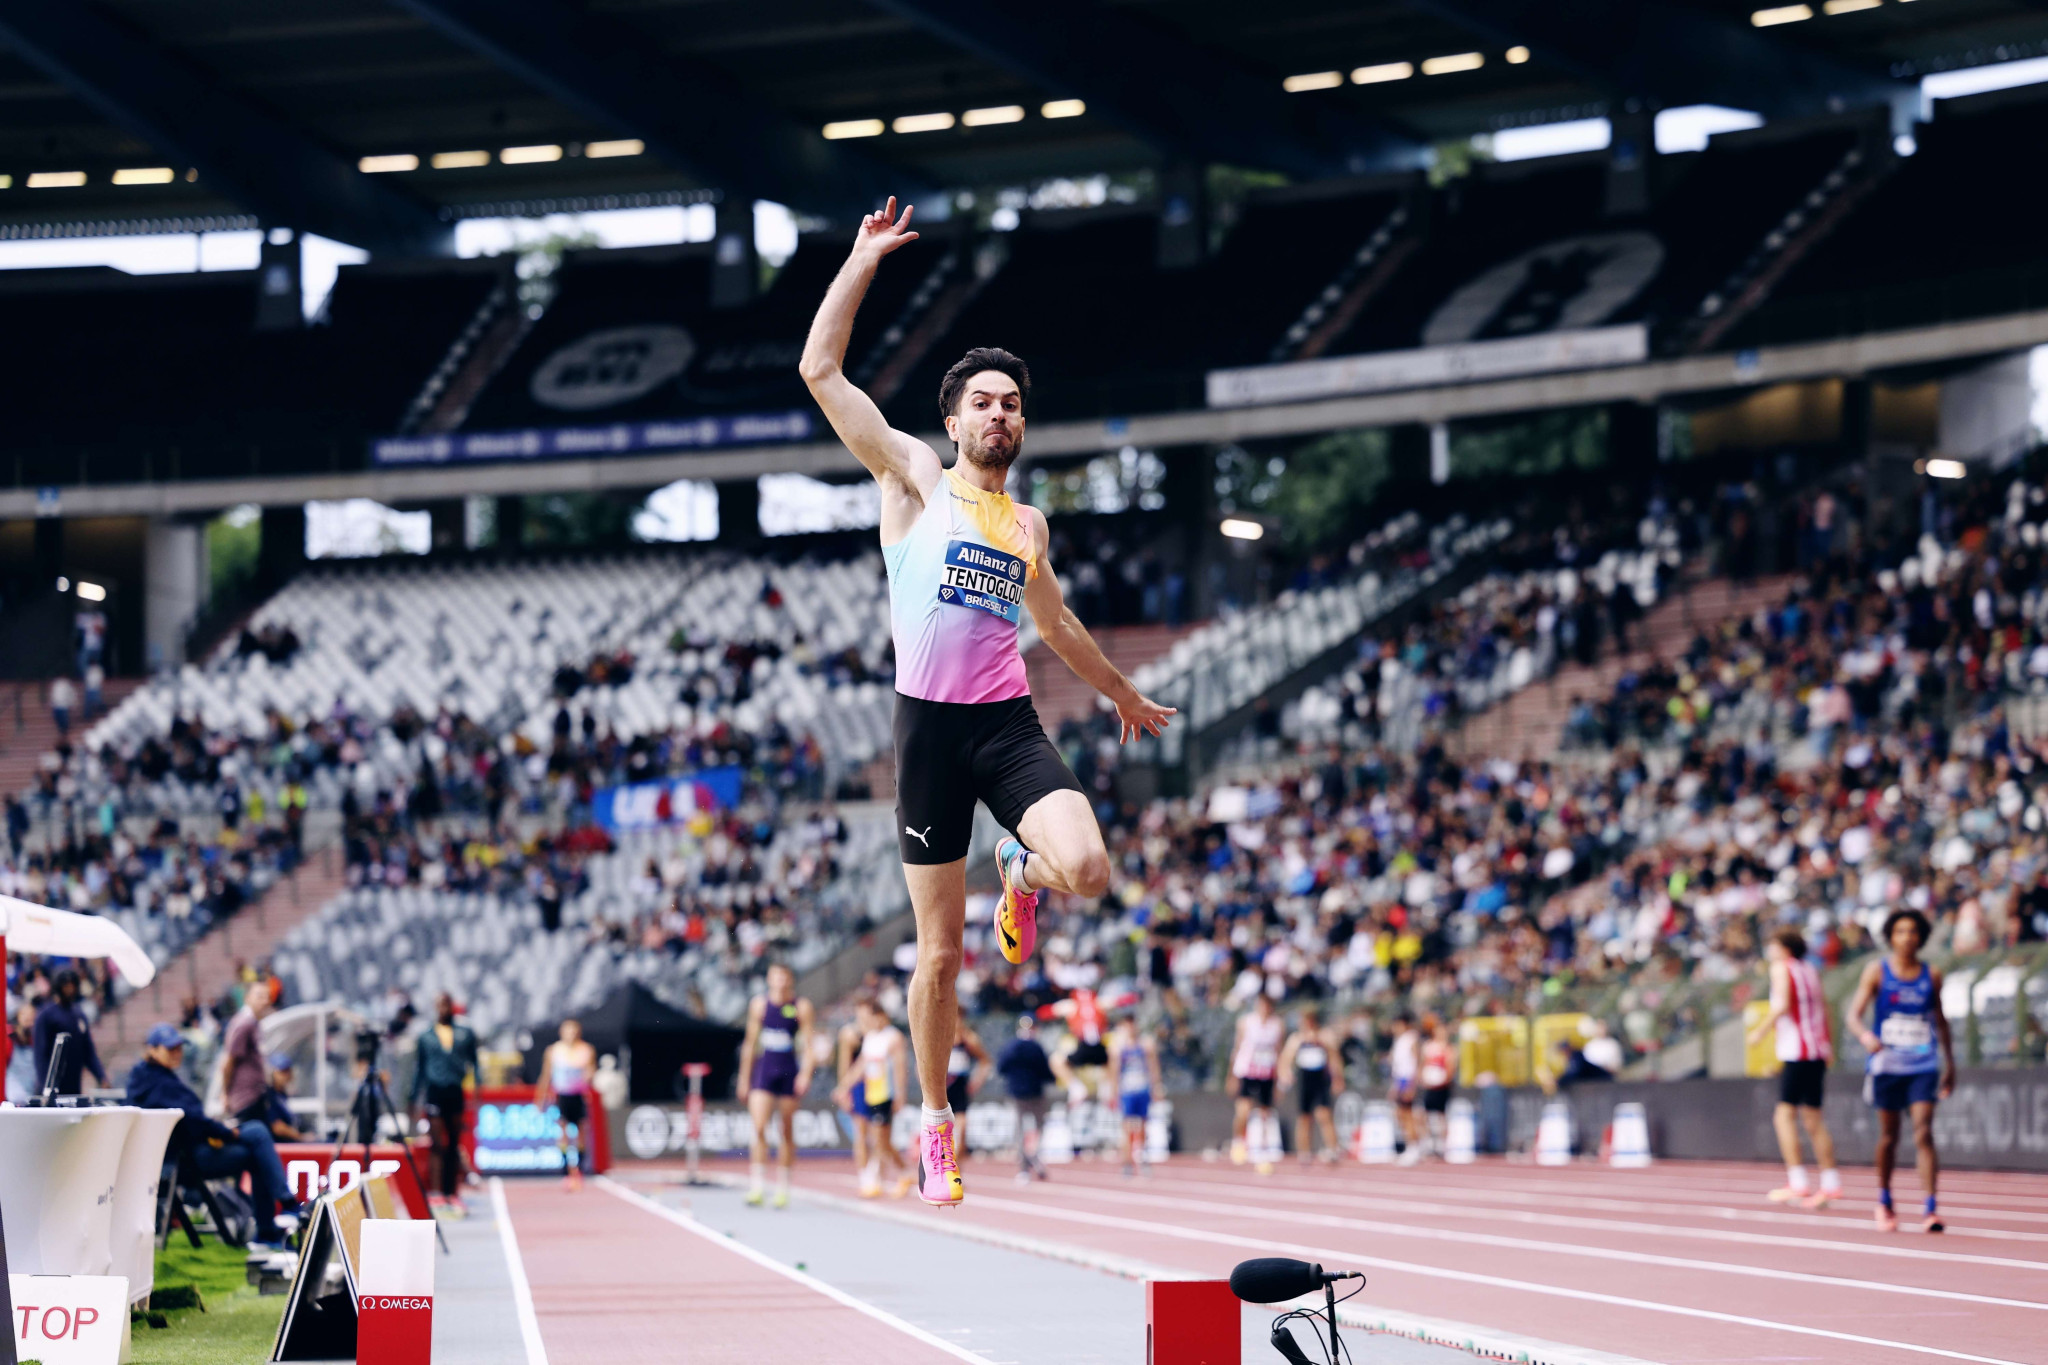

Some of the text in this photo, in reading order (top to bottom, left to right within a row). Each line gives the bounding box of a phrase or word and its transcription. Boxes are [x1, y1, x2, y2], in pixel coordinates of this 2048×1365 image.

[957, 547, 1008, 572] Allianz
[946, 566, 1022, 605] TENTOGLOU
[964, 594, 1009, 616] BRUSSELS
[380, 1298, 431, 1310] OMEGA
[17, 1306, 99, 1340] TOP
